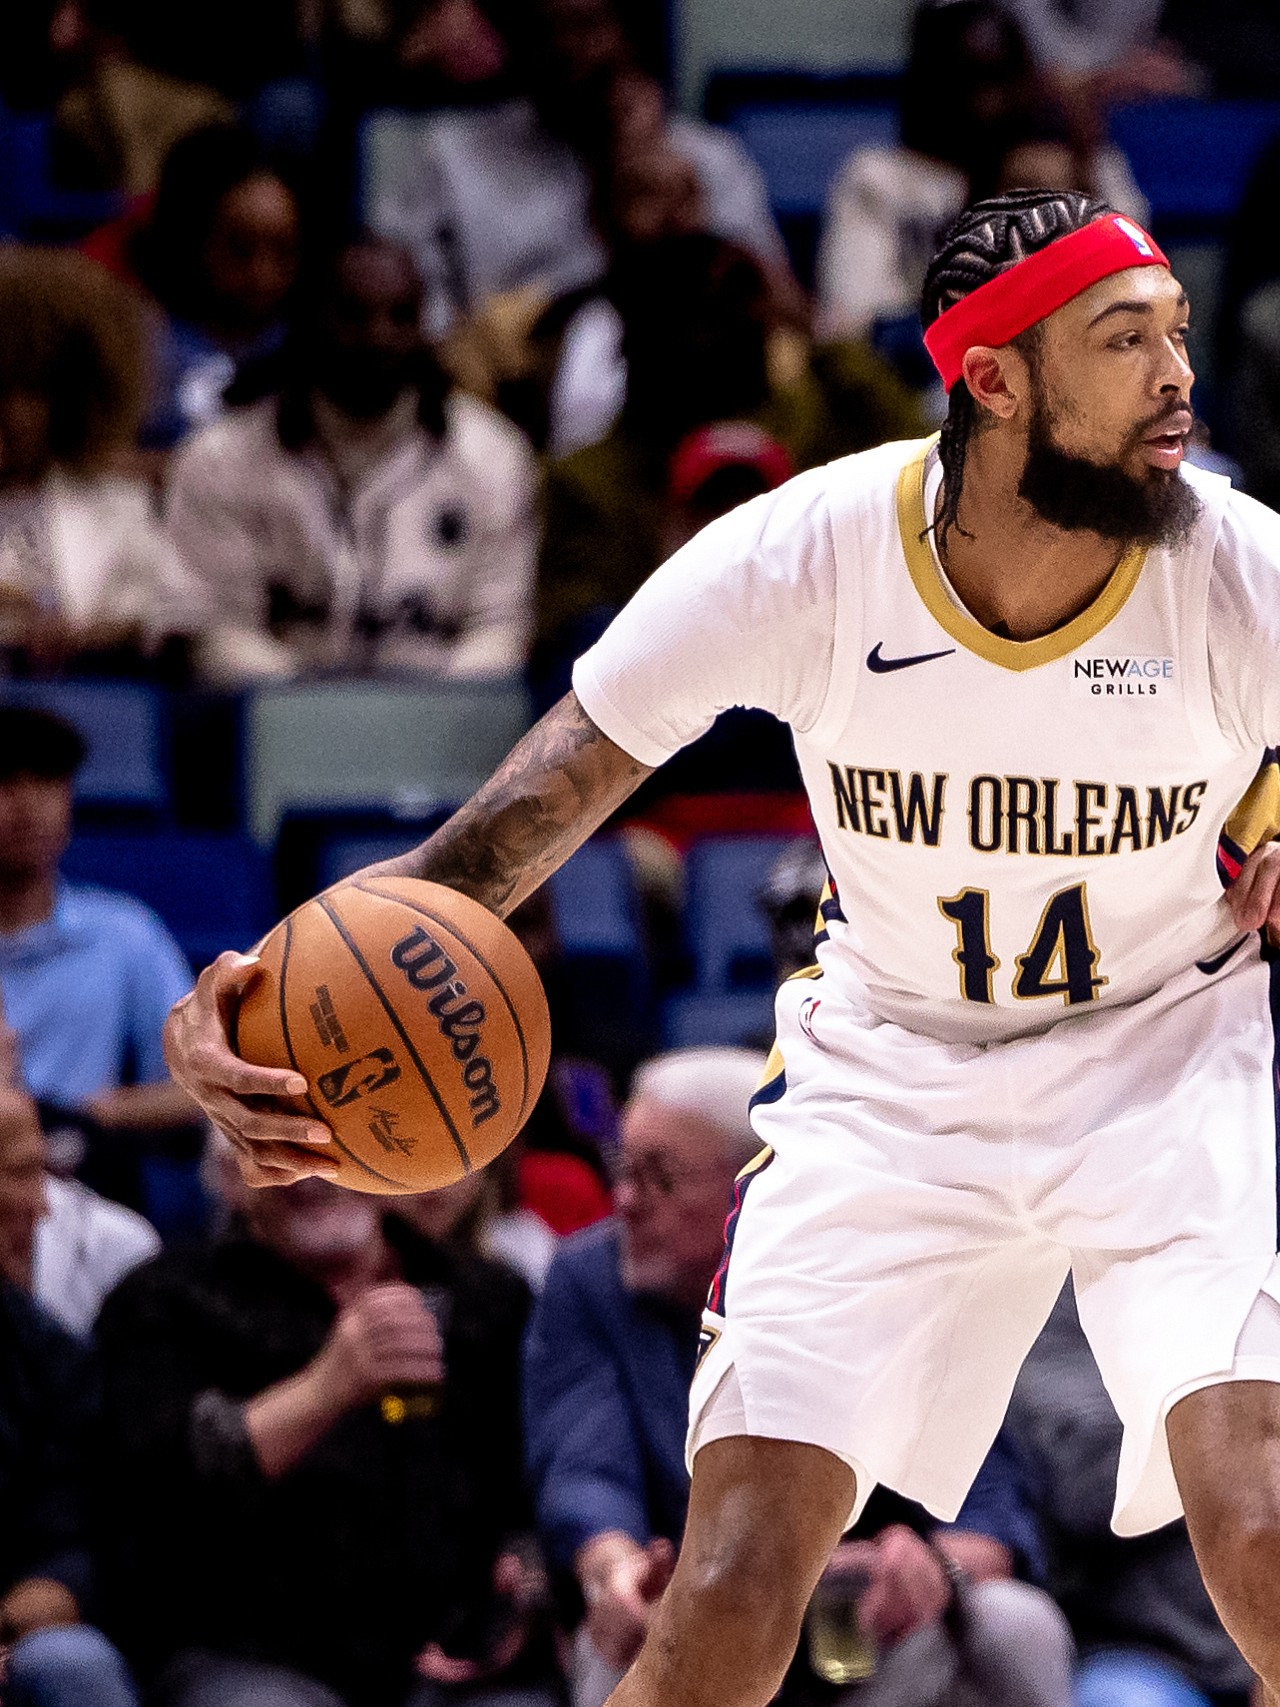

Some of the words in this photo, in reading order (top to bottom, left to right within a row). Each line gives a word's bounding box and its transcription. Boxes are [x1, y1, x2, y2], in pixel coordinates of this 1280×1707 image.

[1074, 658, 1174, 680] NEWAGE
[1091, 684, 1158, 696] GRILLS
[826, 759, 950, 848] NEW
[967, 773, 1209, 857] ORLEANS
[936, 880, 1109, 1006] 14
[389, 924, 501, 1130] Wilson
